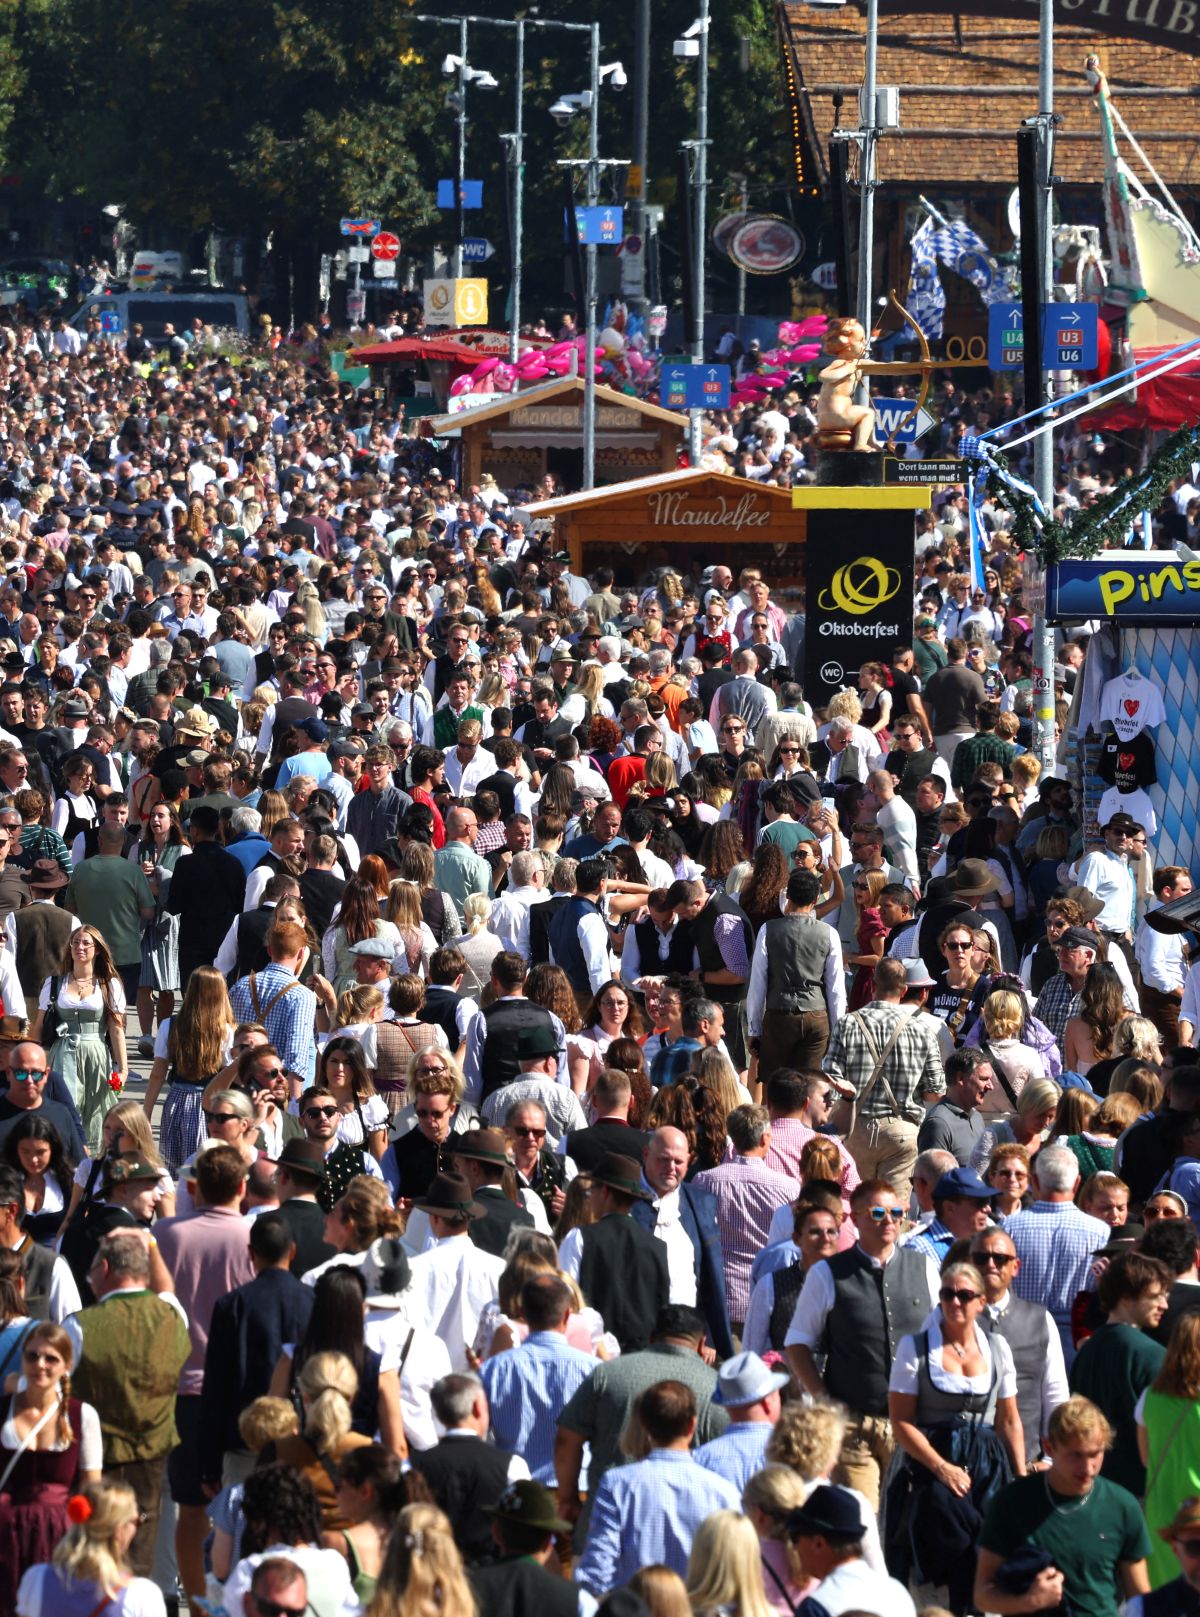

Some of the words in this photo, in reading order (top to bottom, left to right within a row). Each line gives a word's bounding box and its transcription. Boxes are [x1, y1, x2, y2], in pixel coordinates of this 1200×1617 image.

[464, 244, 485, 256] WC
[1006, 332, 1024, 344] U4
[1062, 332, 1079, 343] U3
[1006, 351, 1024, 361] U5
[1061, 350, 1079, 361] U6
[706, 395, 718, 403] U6
[512, 407, 579, 426] Mandel
[598, 409, 639, 428] Max
[875, 409, 915, 433] WC
[898, 462, 917, 471] Dort
[918, 462, 937, 471] kann
[938, 463, 956, 471] man
[898, 474, 919, 482] wenn
[919, 474, 937, 482] man
[647, 491, 770, 531] Mandelfee
[818, 621, 899, 639] Oktoberfest
[824, 668, 840, 677] WC
[934, 993, 975, 1011] MÜNCN
